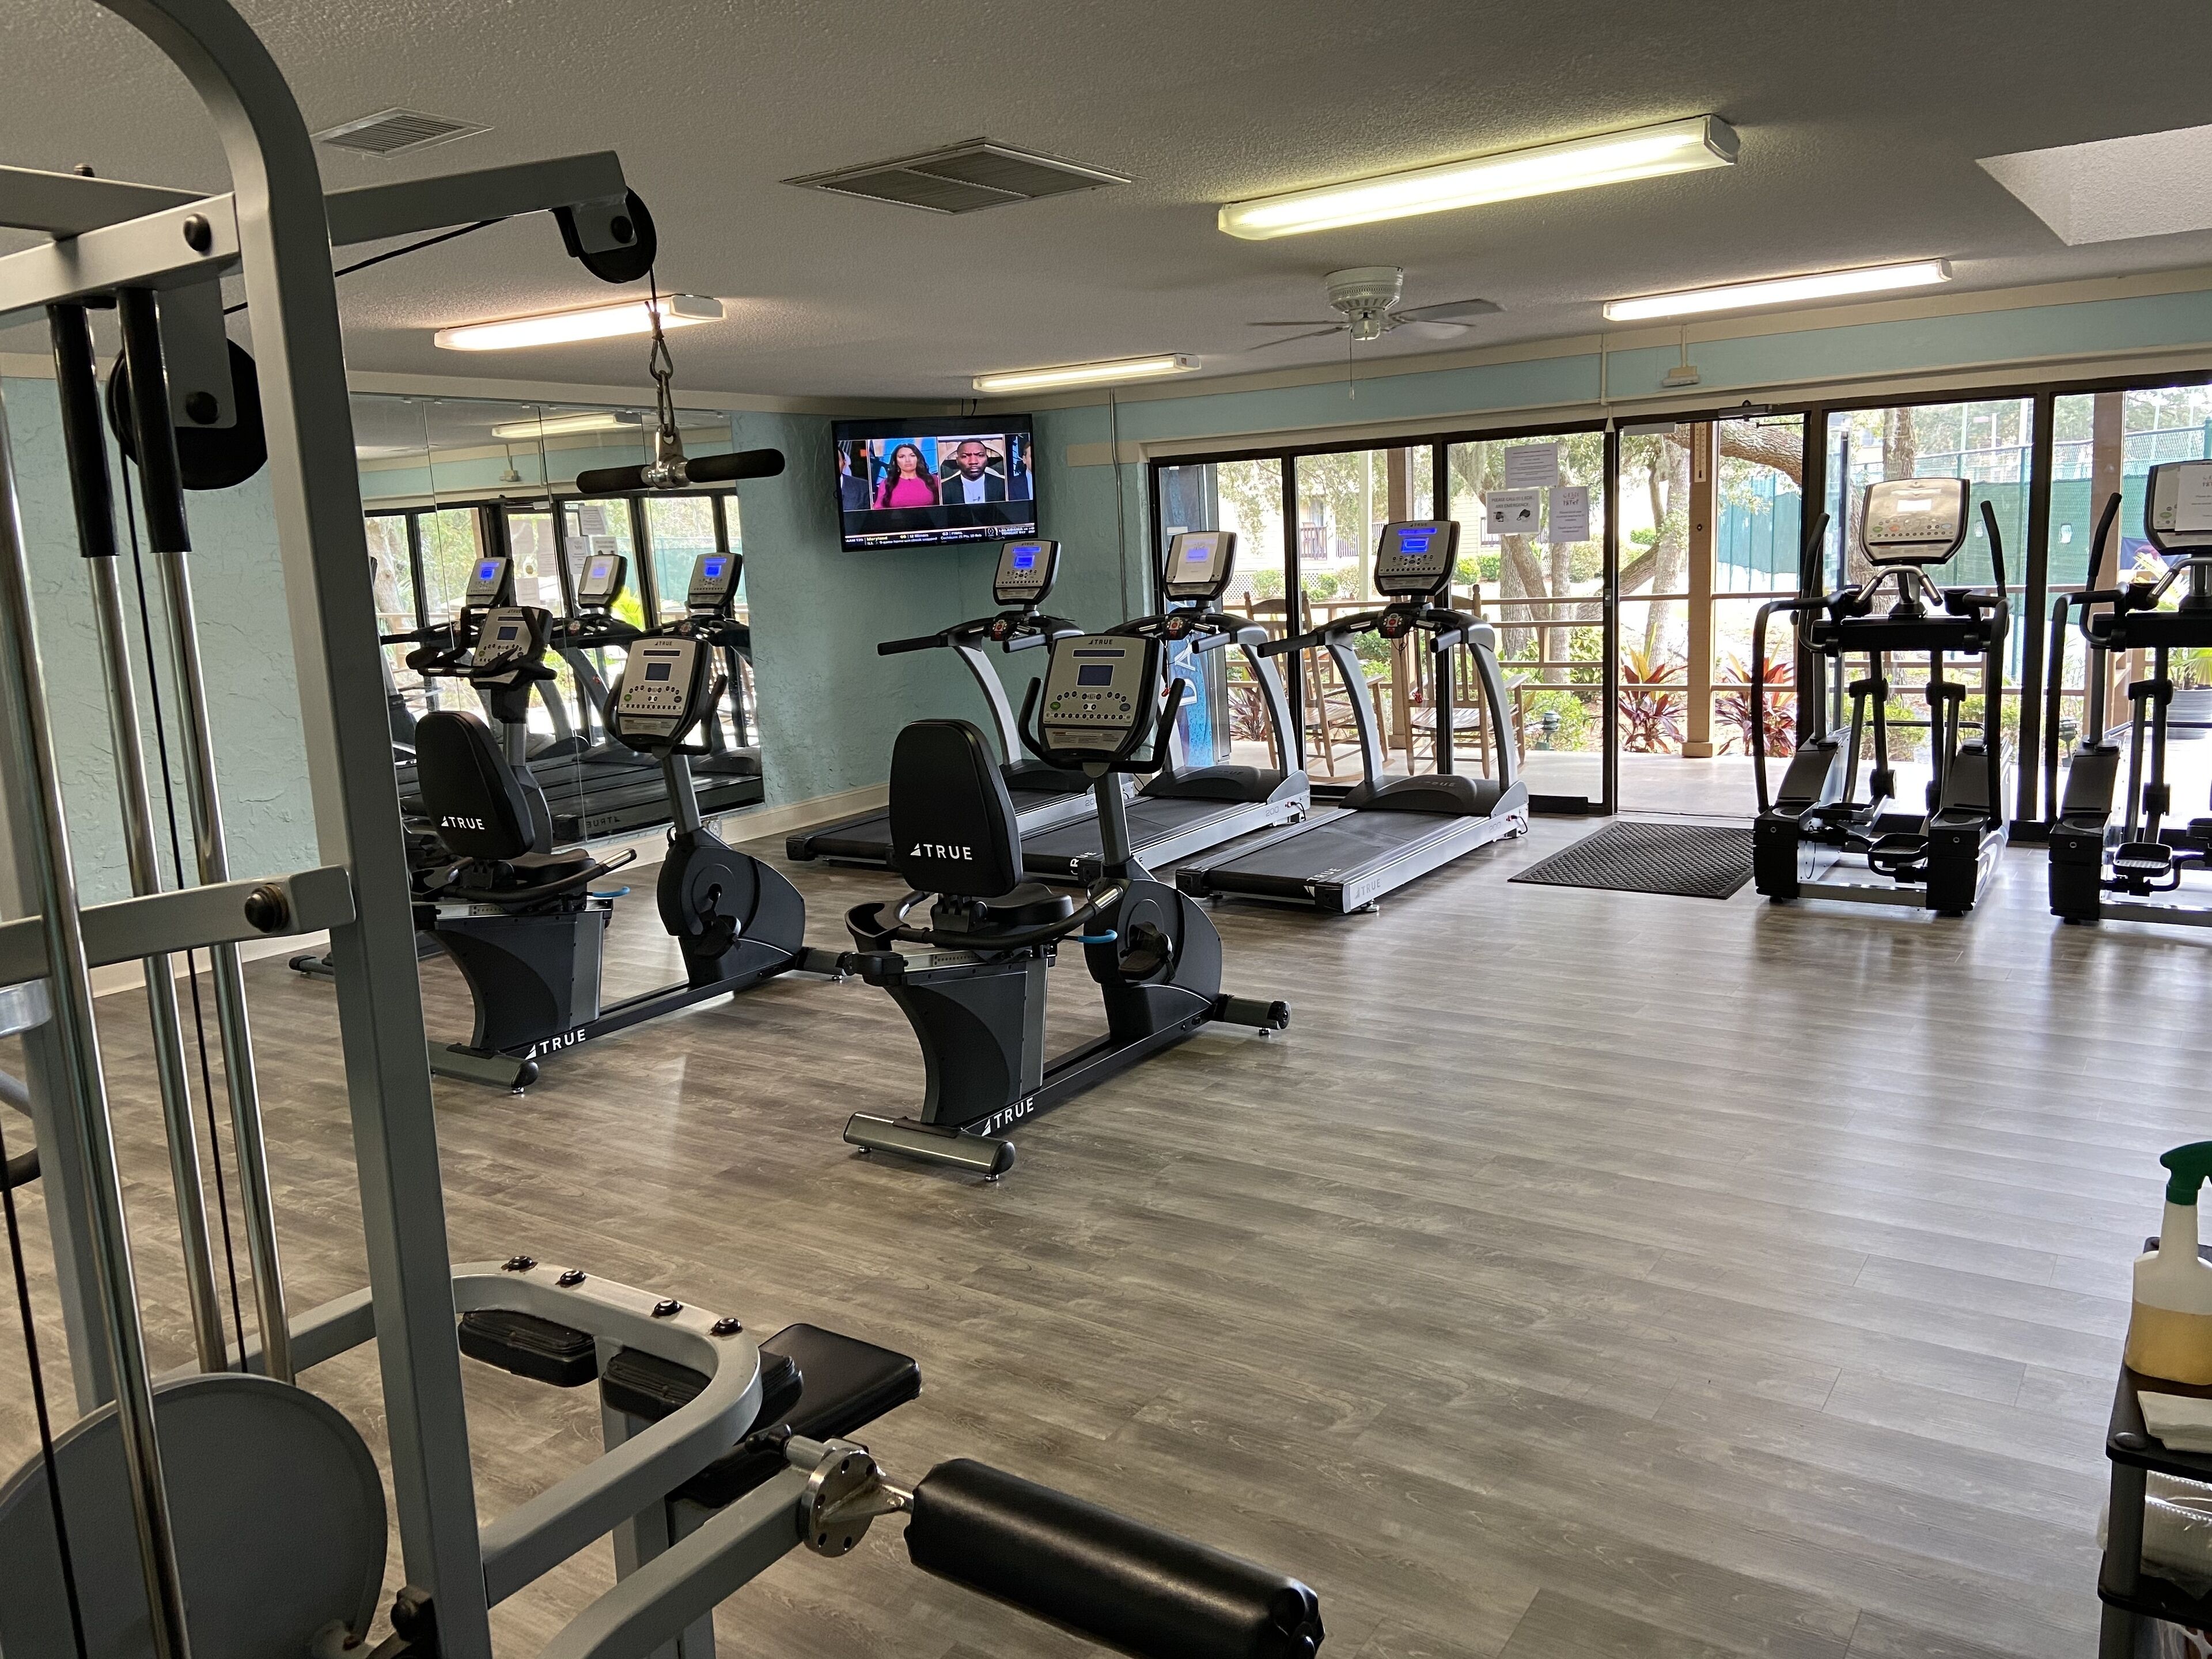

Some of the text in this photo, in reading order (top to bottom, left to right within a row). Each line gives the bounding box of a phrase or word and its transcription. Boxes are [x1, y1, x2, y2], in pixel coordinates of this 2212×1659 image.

[1085, 798, 1097, 807] 20
[1265, 806, 1279, 817] 200
[448, 816, 485, 830] TRUE
[1488, 821, 1501, 833] 200
[923, 843, 973, 860] TRUE
[1306, 868, 1342, 882] TRUE
[1361, 878, 1381, 896] TRUE
[539, 1028, 586, 1054] TRUE
[993, 1097, 1034, 1128] TRUE
